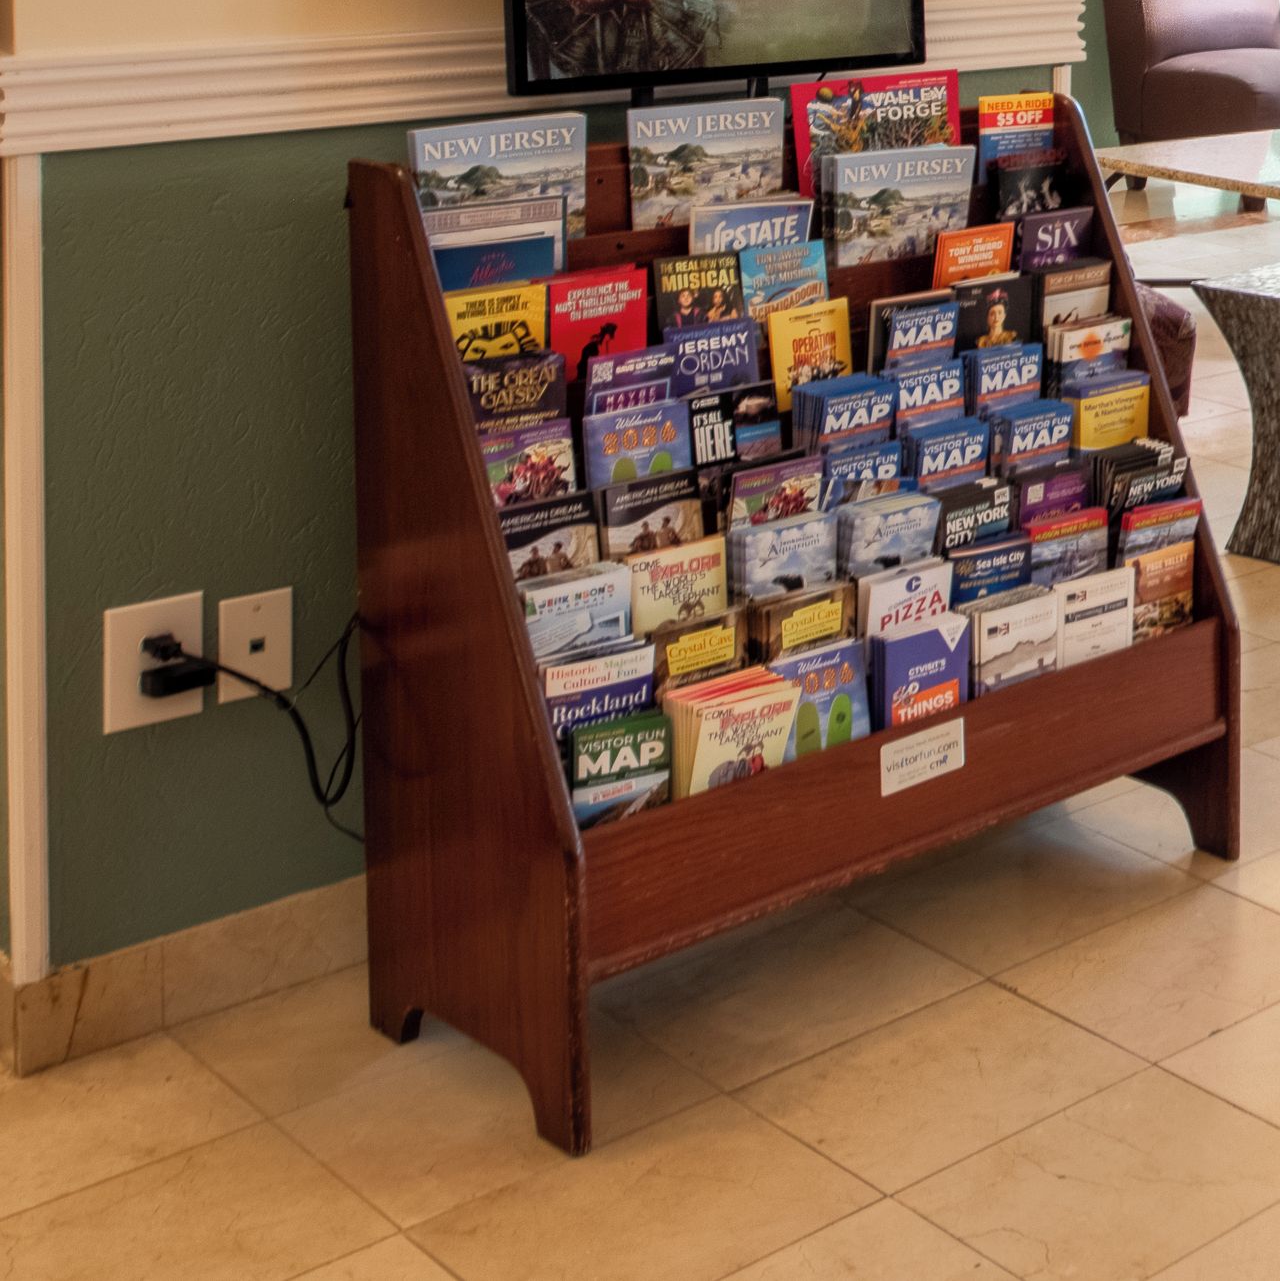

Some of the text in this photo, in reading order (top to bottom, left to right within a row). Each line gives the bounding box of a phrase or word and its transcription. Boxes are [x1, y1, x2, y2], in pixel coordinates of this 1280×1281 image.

[870, 85, 946, 108] VALLEY
[987, 98, 1052, 112] NEED A RIDE?
[876, 101, 943, 123] FORGE
[997, 110, 1044, 127] $5 OFF
[636, 111, 776, 139] NEW JERSEY
[424, 127, 577, 161] NEW JERSEY
[843, 157, 968, 184] NEW JERSEY
[704, 214, 799, 254] UPSTATE
[949, 240, 1003, 258] TONY AWARD
[958, 251, 994, 265] WINNING
[675, 260, 699, 272] REAL
[567, 280, 630, 301] EXPERIENCE THE
[661, 269, 739, 293] MUSICAL
[465, 298, 487, 311] THERE
[555, 289, 642, 314] MOST THRILLING NIGHT
[570, 309, 582, 321] ON
[896, 311, 955, 330] VISITOR FUN
[679, 331, 748, 355] JEREMY
[792, 331, 837, 355] OPERATION
[892, 321, 954, 350] MAP
[635, 362, 646, 370] UP
[647, 359, 658, 367] TO
[981, 360, 1018, 375] VISITOR
[1019, 353, 1039, 366] FUN
[471, 363, 559, 394] THE GREAT
[899, 367, 961, 389] VISITOR FUN
[980, 363, 1039, 394] MAP
[480, 382, 549, 410] GATSBY
[827, 393, 894, 415] VISITOR FUN
[899, 380, 961, 411] MAP
[1084, 392, 1146, 412] Martha's Vineyard
[694, 411, 722, 426] IT'S ALL
[823, 403, 891, 435] MAP
[1101, 403, 1135, 417] Nantucket
[1014, 416, 1071, 435] VISITOR FUN
[694, 421, 736, 465] HERE
[923, 434, 984, 454] VISITOR FUN
[1011, 425, 1069, 454] MAP
[831, 453, 898, 476] VISITOR FUN
[921, 445, 983, 476] MAP
[615, 479, 690, 504] AMERICAN DREAM
[1128, 473, 1184, 497] NEW YORK
[946, 502, 991, 518] OFFICIAL MAP
[1125, 493, 1149, 509] CITY
[500, 502, 583, 528] AMERICAN DREAM
[946, 515, 975, 535] NEW
[975, 505, 1010, 526] YORK
[873, 521, 922, 540] Aquarium
[946, 530, 974, 550] CITY
[1061, 523, 1078, 535] RIVER
[768, 537, 821, 558] Aquarium
[976, 550, 1026, 569] Sea Isle City
[632, 553, 721, 583] COME EXPLORE
[640, 572, 706, 596] THE WORLD'S
[654, 582, 694, 601] LARGEST
[672, 585, 721, 606] ELEPHANT
[783, 605, 841, 631] Crystal Cave
[880, 589, 944, 632] PIZZA
[668, 631, 734, 660] Crystal Cave
[551, 653, 648, 681] Historic Majestic
[563, 667, 638, 691] Cultural Fun
[553, 684, 648, 725] Rockland
[704, 699, 793, 731] COME EXPLORE
[898, 689, 955, 723] THINGS
[578, 728, 666, 754] VISITOR FUN
[708, 730, 727, 741] THE
[577, 741, 665, 780] MAP
[885, 739, 960, 774] visitorfun.com
